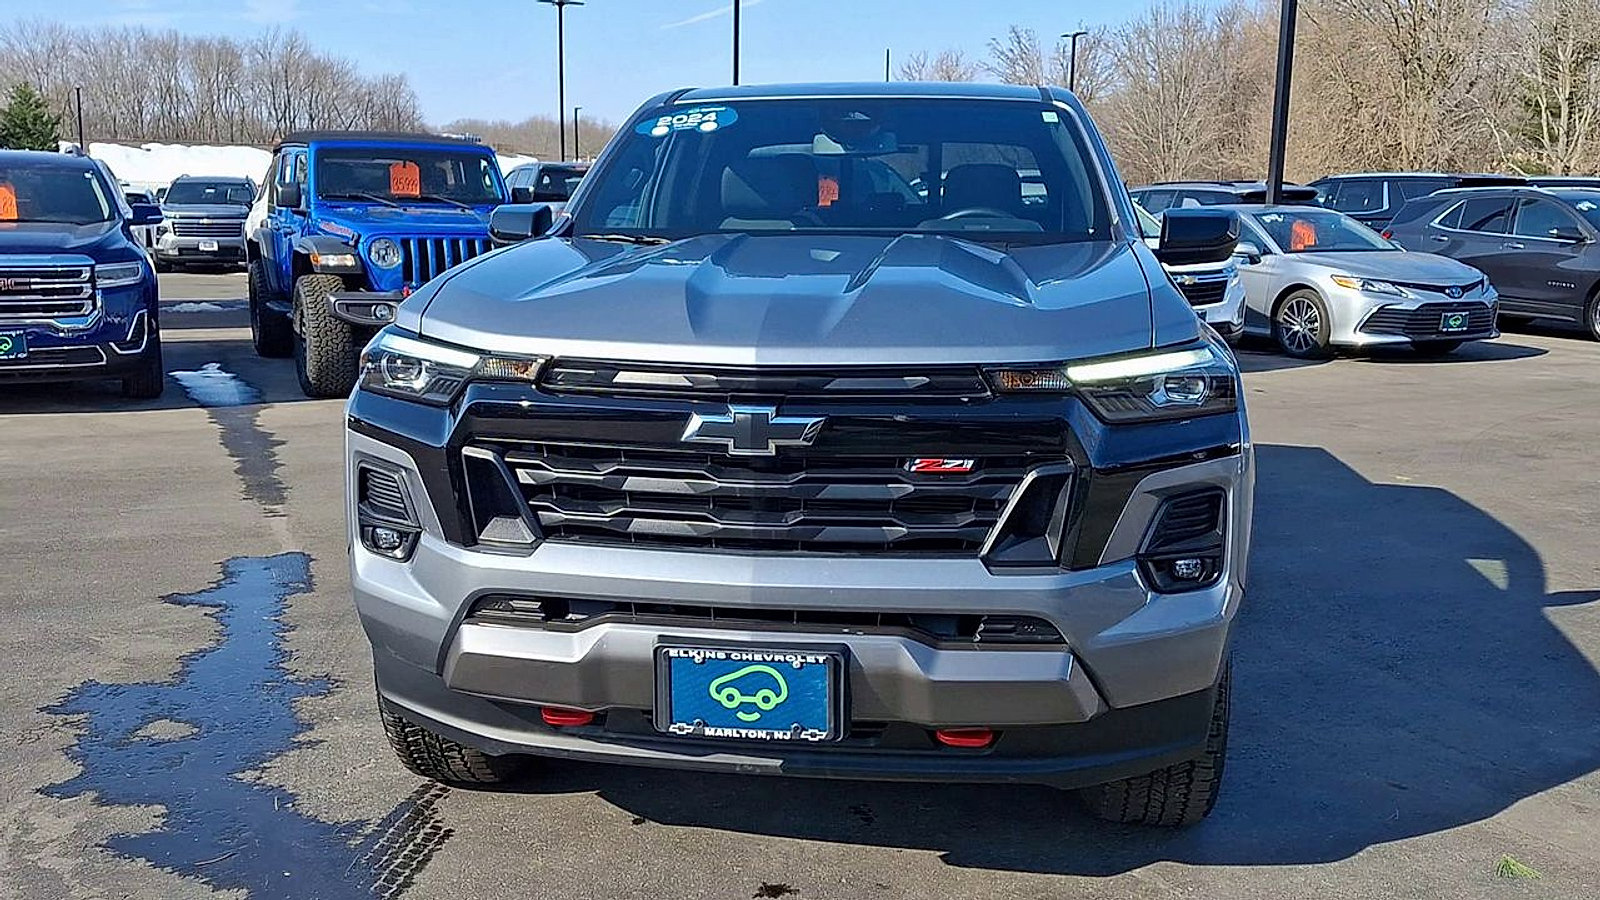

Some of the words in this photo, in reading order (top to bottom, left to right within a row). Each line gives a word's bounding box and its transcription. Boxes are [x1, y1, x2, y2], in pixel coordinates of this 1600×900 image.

[656, 112, 717, 127] 2024
[910, 458, 975, 472] Z71
[669, 649, 727, 660] ELKINS
[730, 652, 828, 664] CHEVROLET
[704, 727, 771, 740] MARLTON,
[773, 730, 792, 741] NJ
